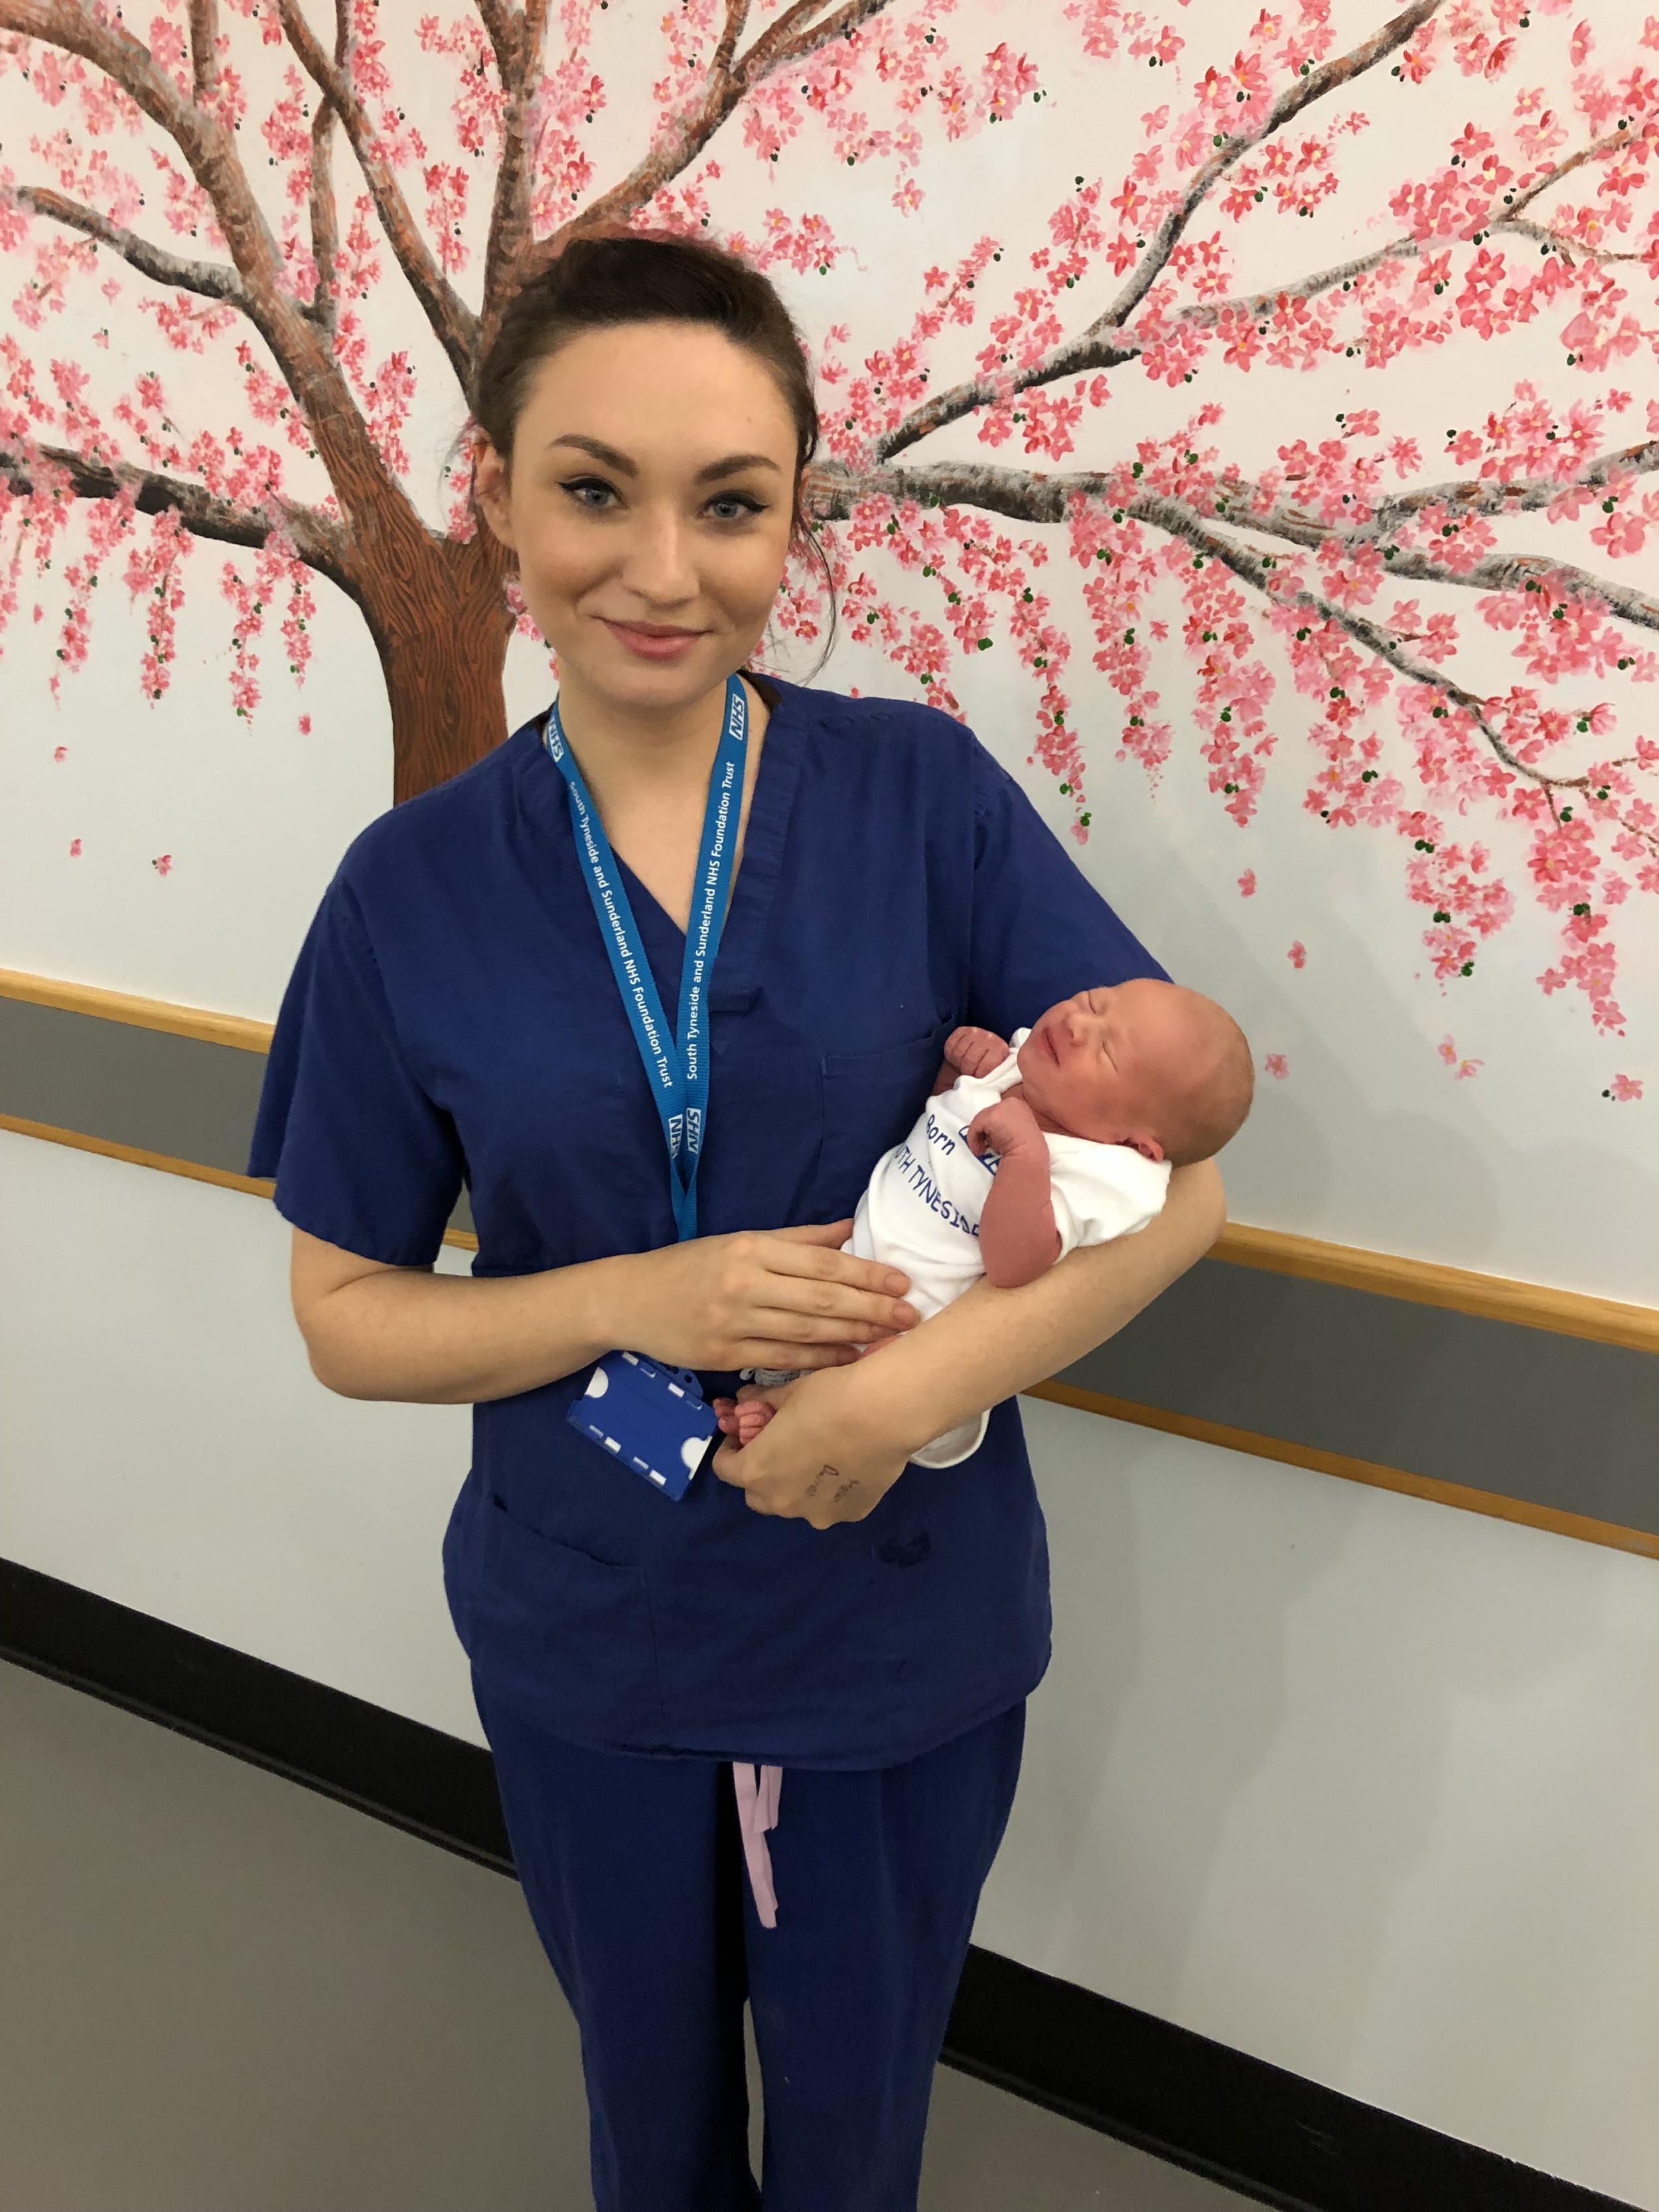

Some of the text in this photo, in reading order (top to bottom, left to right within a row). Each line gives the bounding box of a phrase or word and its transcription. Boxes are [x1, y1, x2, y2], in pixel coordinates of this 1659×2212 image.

[549, 716, 564, 761] NHS
[729, 693, 745, 741] NHS
[569, 781, 673, 1088] South Tyneside and Sunderland NHS Foundation Trust
[686, 761, 735, 1080] South Tyneside and Sunderland NHS Foundation Trust
[669, 1114, 682, 1158] NHS
[686, 1108, 701, 1153] NHS
[926, 1114, 956, 1155] Born
